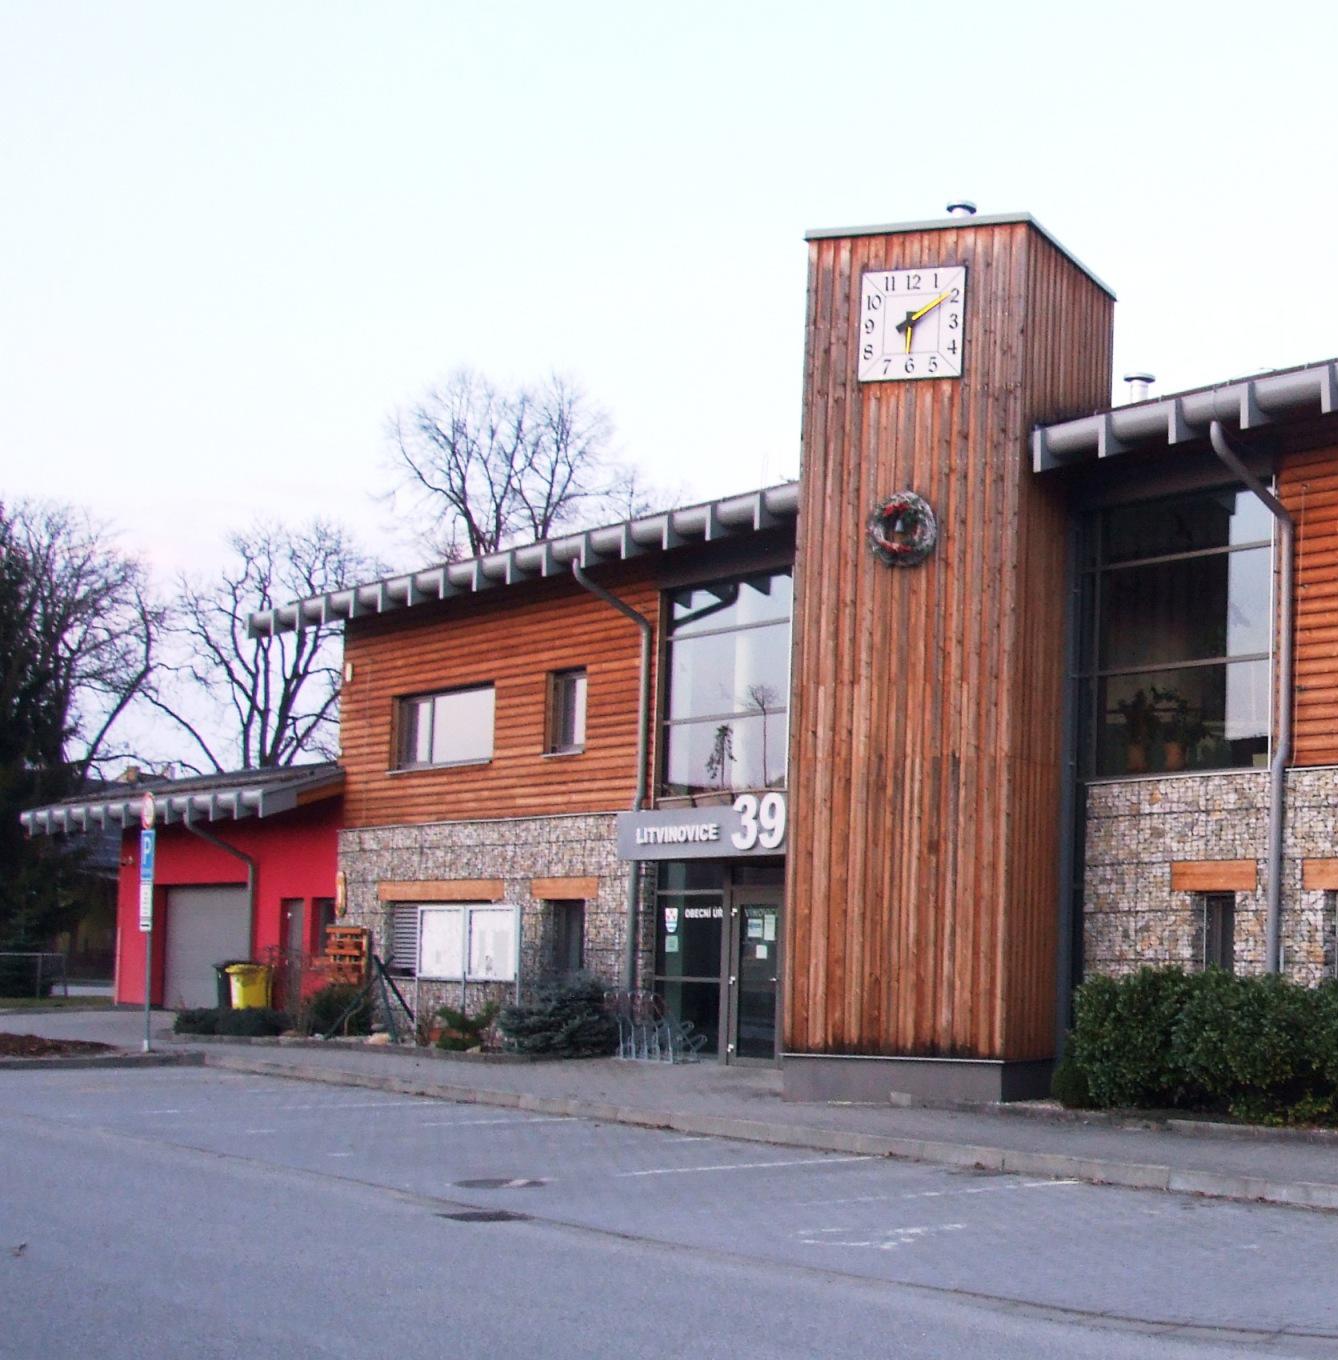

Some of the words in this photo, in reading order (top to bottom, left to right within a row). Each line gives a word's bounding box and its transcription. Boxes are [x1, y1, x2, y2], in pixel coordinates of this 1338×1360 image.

[885, 276, 895, 291] 11
[907, 274, 921, 290] 12
[867, 295, 881, 310] 10
[950, 288, 959, 303] 2
[865, 319, 874, 334] 9
[949, 314, 958, 329] 3
[864, 344, 873, 360] 8
[947, 340, 957, 354] 4
[883, 360, 891, 374] 7
[905, 358, 914, 373] 6
[928, 357, 937, 372] 5
[636, 823, 719, 844] LITVINOVICE
[731, 792, 785, 849] 39
[144, 836, 151, 864] P
[685, 906, 711, 918] OBECNÍ
